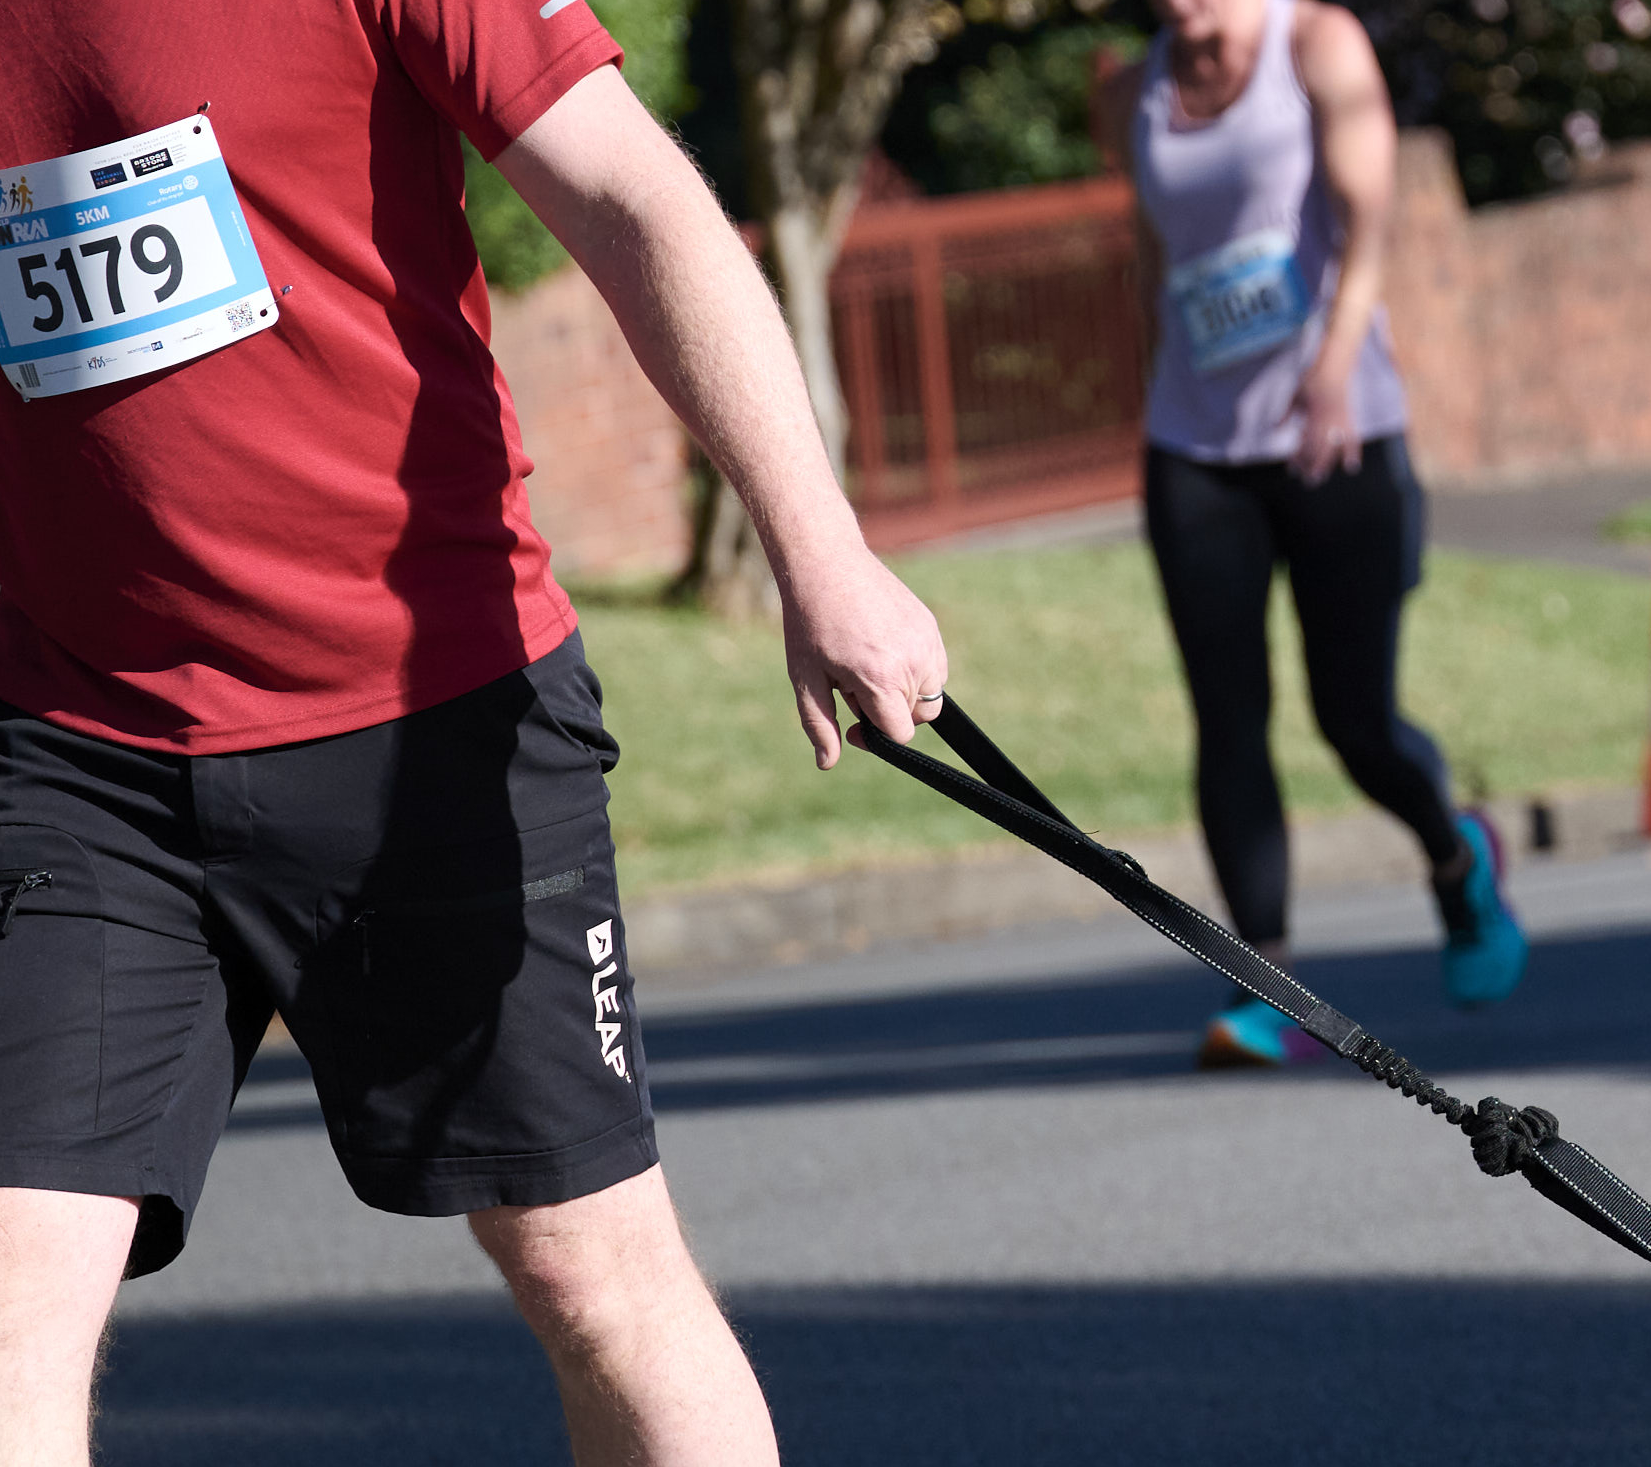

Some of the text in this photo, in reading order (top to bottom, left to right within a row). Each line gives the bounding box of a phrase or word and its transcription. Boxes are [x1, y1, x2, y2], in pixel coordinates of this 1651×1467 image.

[141, 155, 168, 168] STONE
[159, 183, 183, 196] Rotary
[76, 205, 111, 226] 5KM
[18, 224, 183, 332] 5179
[592, 960, 627, 1079] LEAP
